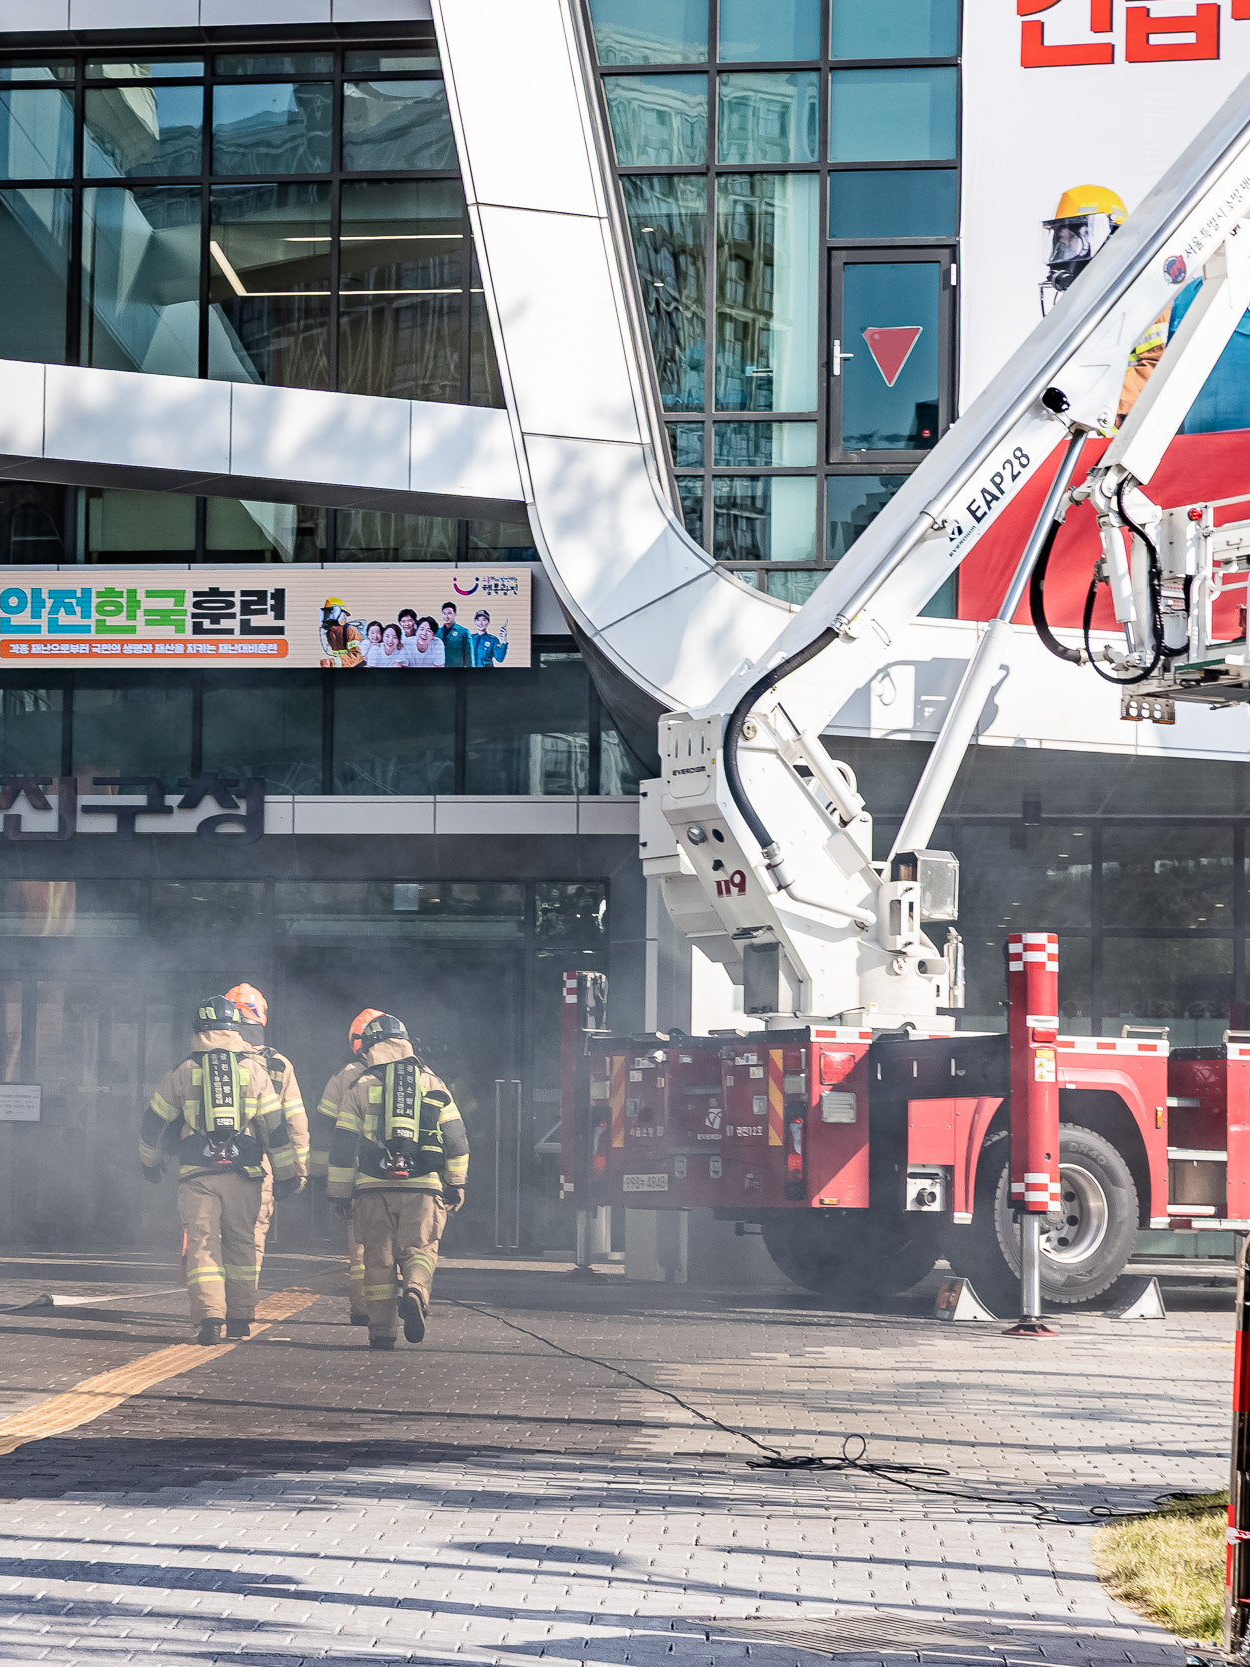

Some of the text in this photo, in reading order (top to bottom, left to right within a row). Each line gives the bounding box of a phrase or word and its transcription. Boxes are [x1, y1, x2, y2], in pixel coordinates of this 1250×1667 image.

[966, 446, 1030, 524] EAP28
[0, 587, 286, 635] 안전한국훈련
[714, 869, 747, 898] 119
